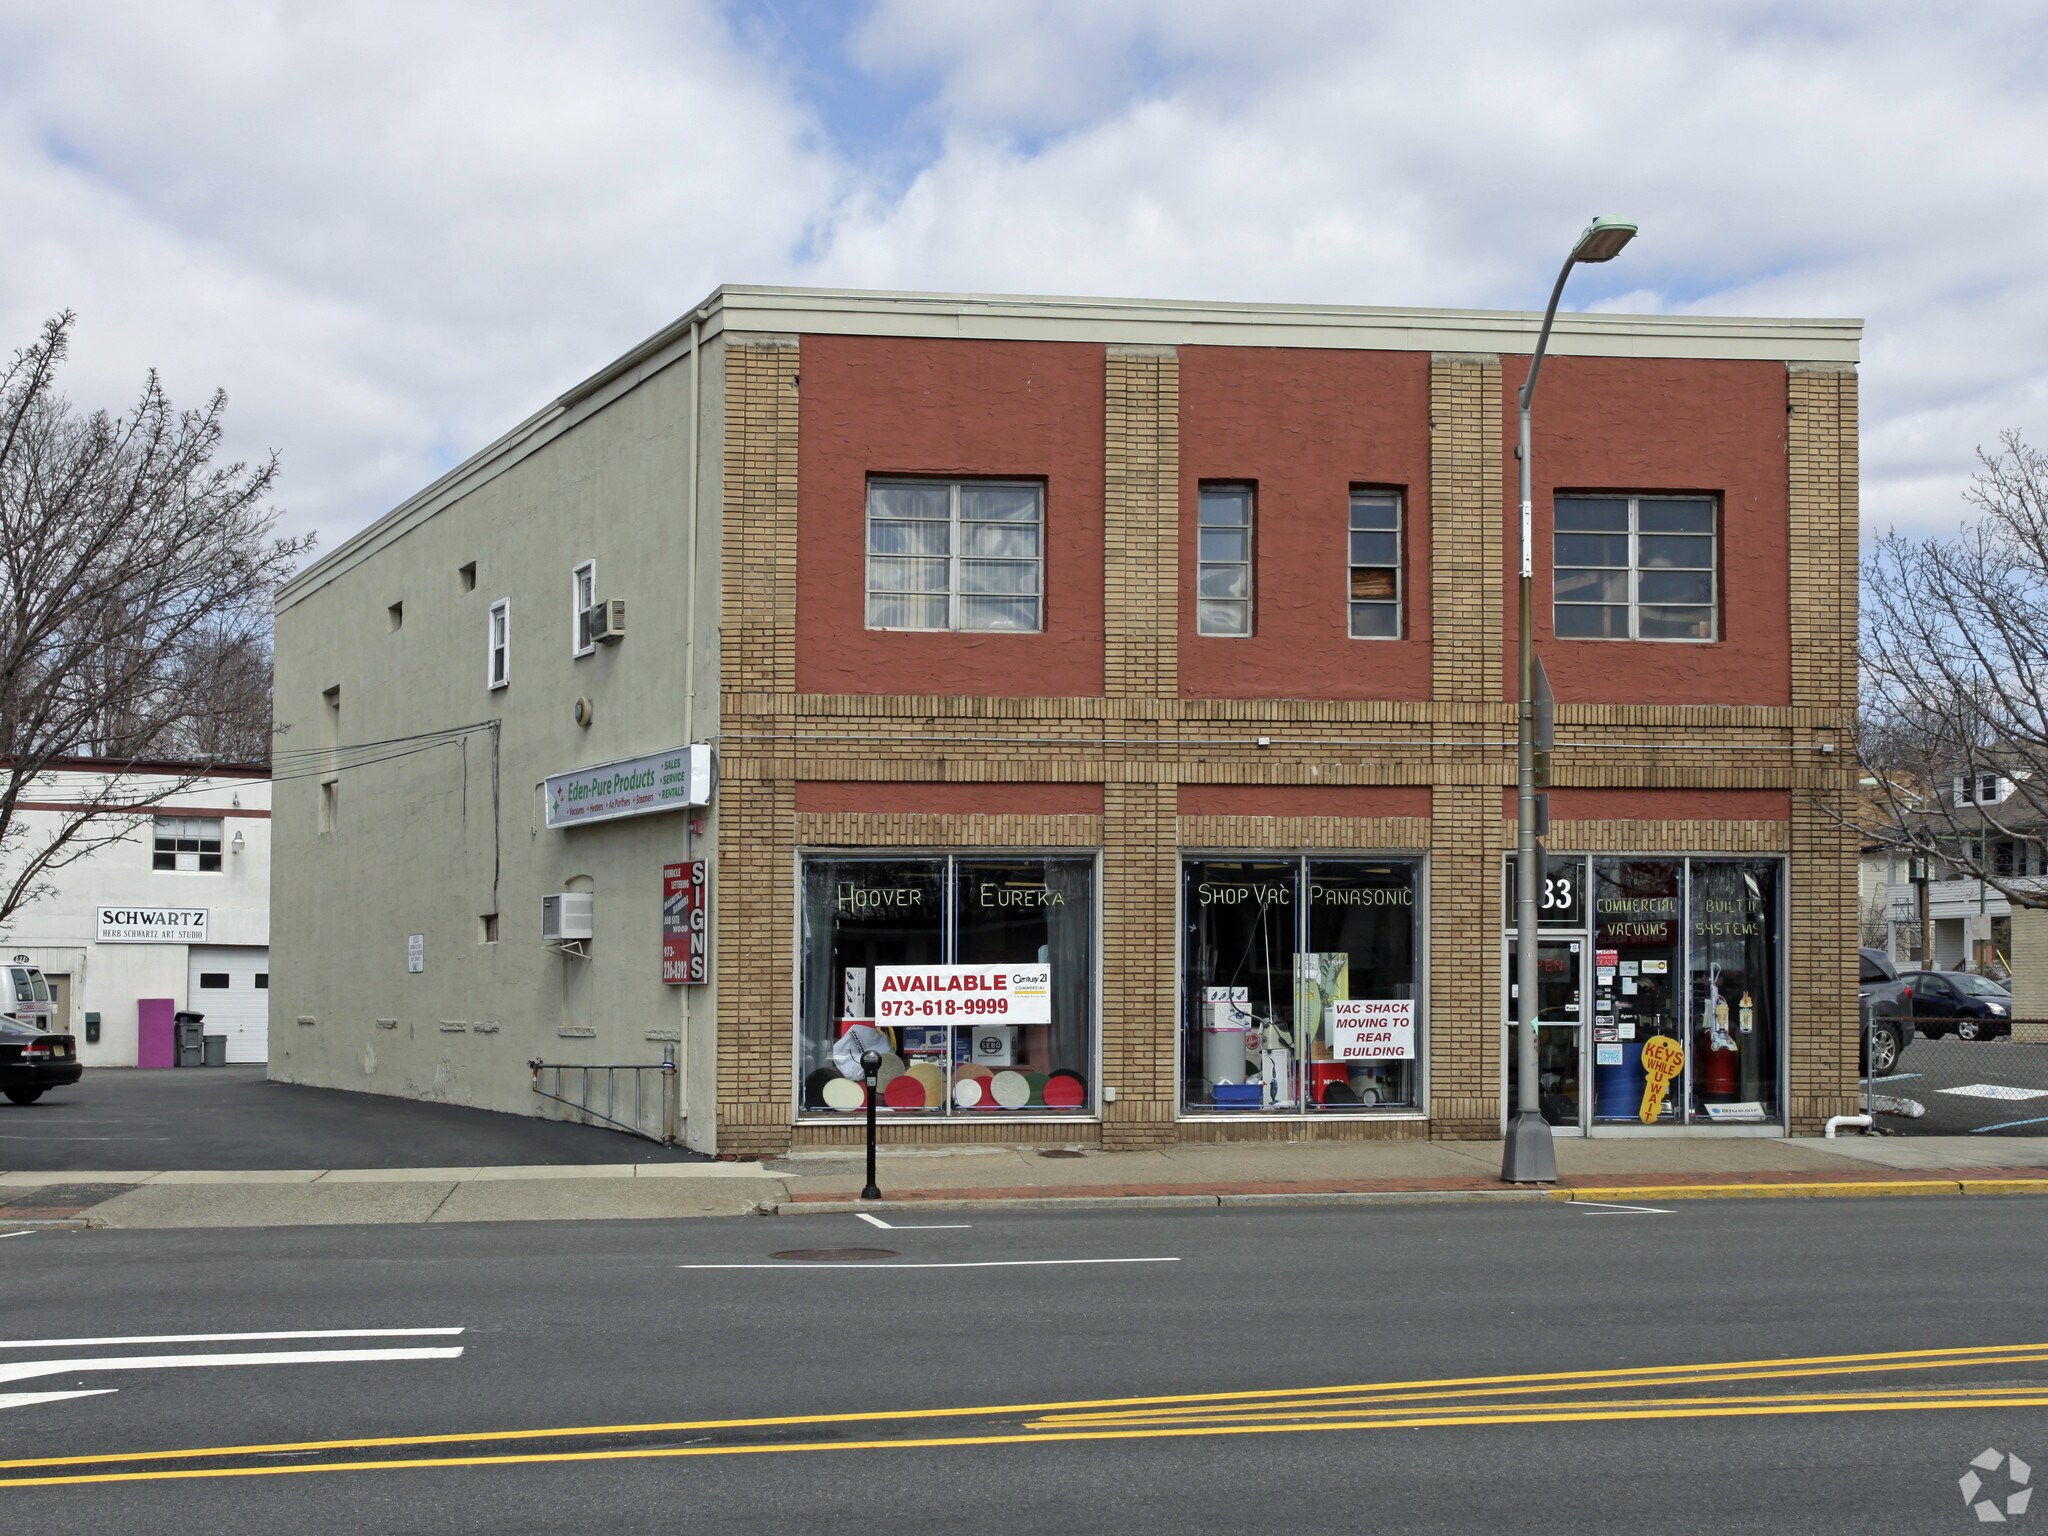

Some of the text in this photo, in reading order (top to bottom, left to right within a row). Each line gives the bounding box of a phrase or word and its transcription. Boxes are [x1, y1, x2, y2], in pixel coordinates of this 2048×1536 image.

[664, 758, 681, 770] SALES
[568, 768, 655, 801] Eden-Pure Products
[662, 771, 685, 785] SERVICE
[661, 786, 685, 799] RENTALS
[590, 803, 604, 812] Heaters
[636, 794, 654, 804] Steamers
[665, 868, 681, 878] VEHICLE
[671, 880, 689, 889] LETTERING
[838, 884, 922, 913] HOOVER
[981, 883, 1065, 907] EUREKA
[1198, 883, 1289, 906] SHOP VAC
[1310, 885, 1412, 905] PANASONIC
[1541, 879, 1572, 909] 33
[1597, 899, 1676, 912] COMMERCIAL
[1706, 900, 1742, 912] BUILT
[102, 910, 204, 926] SCHWARTZ
[672, 916, 680, 924] SITE
[690, 862, 704, 979] SIGNS
[102, 929, 203, 939] HERB SCHWARTZ ART STUDIO
[1608, 923, 1668, 936] VACUUMS
[1696, 922, 1759, 936] SYSTEMS
[881, 975, 1007, 992] AVAILABLE
[1013, 973, 1047, 984] Century 21
[881, 998, 1008, 1017] 973-618-9999
[1336, 1003, 1410, 1014] VAC SHACK
[1336, 1018, 1409, 1028] MOVING TO
[1356, 1033, 1391, 1042] REAR
[1343, 1047, 1405, 1056] BUILDING
[1645, 1043, 1683, 1066] KEYS
[1647, 1058, 1675, 1075] WHILE
[1654, 1072, 1663, 1082] U
[1645, 1083, 1662, 1122] WAIT
